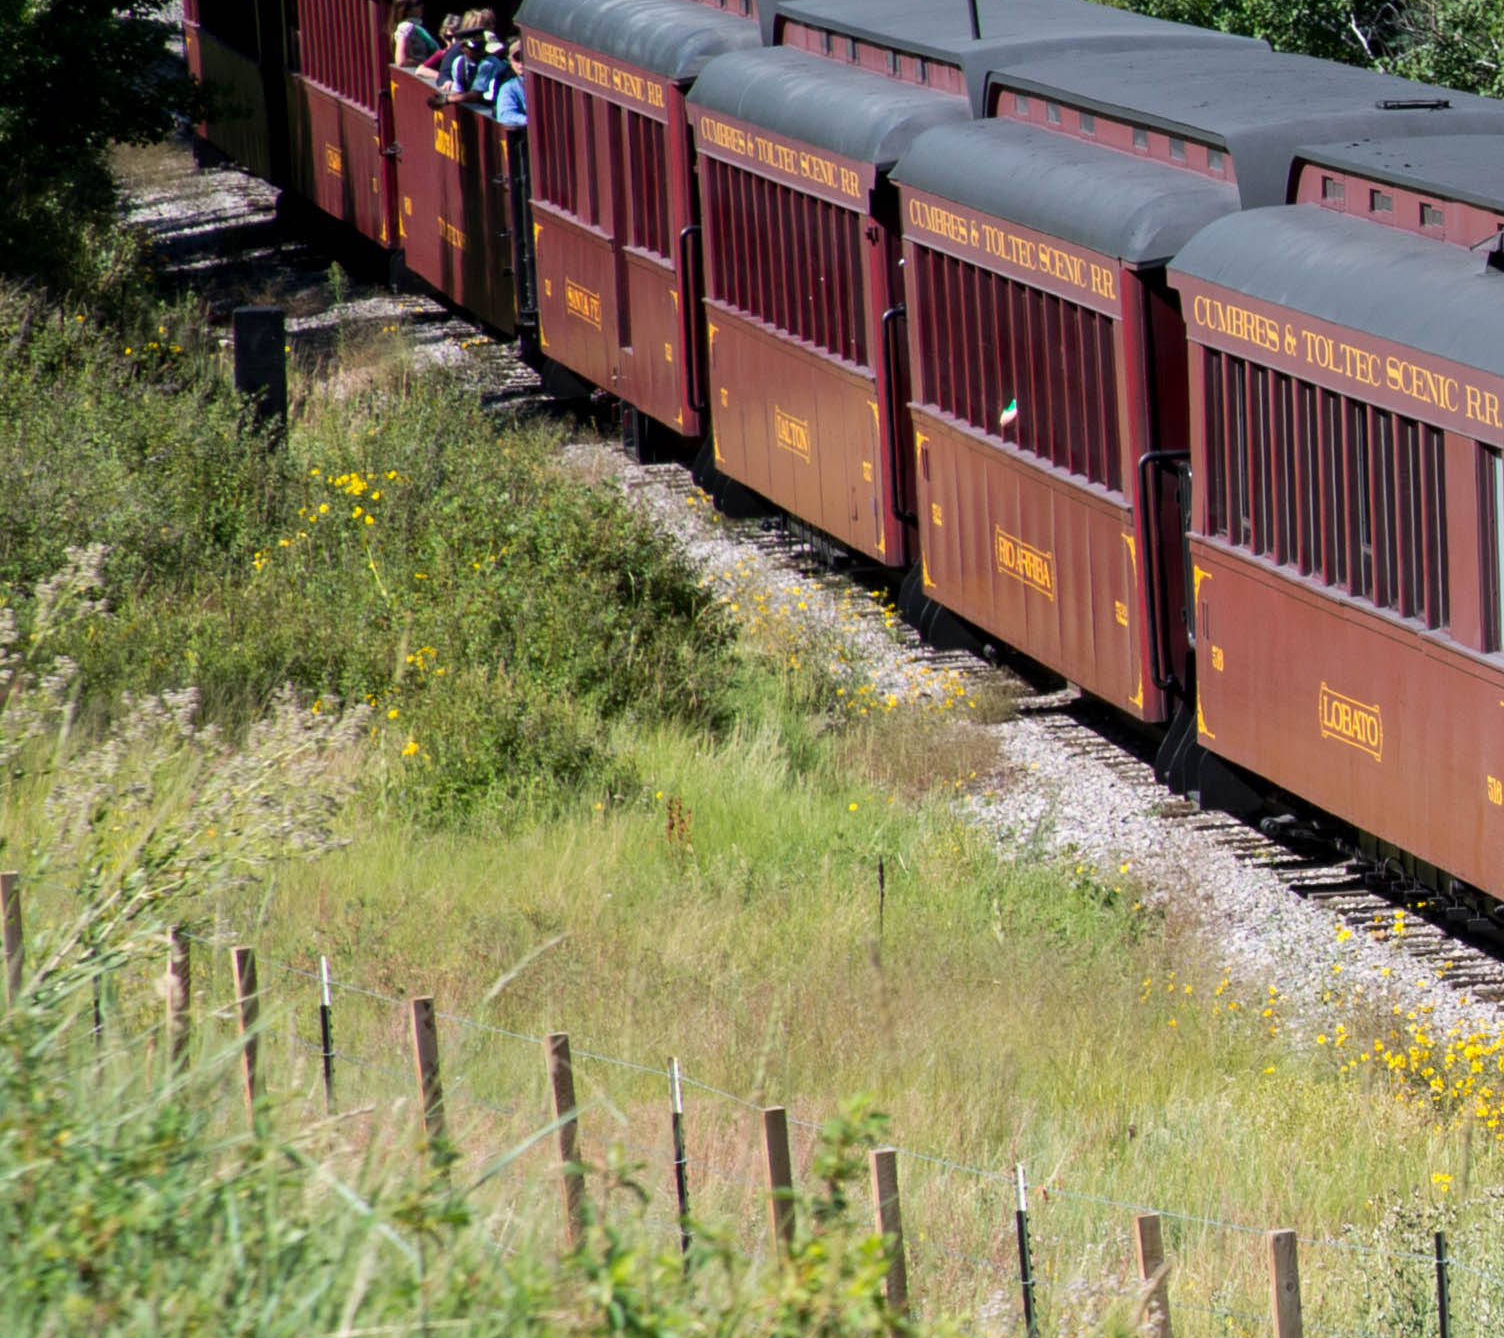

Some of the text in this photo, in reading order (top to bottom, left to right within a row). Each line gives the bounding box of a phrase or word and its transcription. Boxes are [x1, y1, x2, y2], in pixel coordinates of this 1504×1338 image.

[575, 53, 611, 89] TOLTEC
[612, 68, 646, 102] SCENIC
[700, 116, 747, 156] CUMBRES
[755, 136, 798, 176] TOLTEC
[800, 151, 839, 189] SCENIC
[909, 198, 969, 247] CUMBRES
[970, 220, 980, 249] &
[982, 224, 1037, 272] TOLTEC
[1039, 243, 1087, 289] SCENIC
[1193, 294, 1280, 353] CUMBRES
[1284, 324, 1298, 358] &
[1302, 330, 1382, 388] TOLTEC
[1386, 356, 1459, 413] SCENIC
[998, 536, 1016, 568] RIO
[1322, 695, 1379, 747] LOBATO
